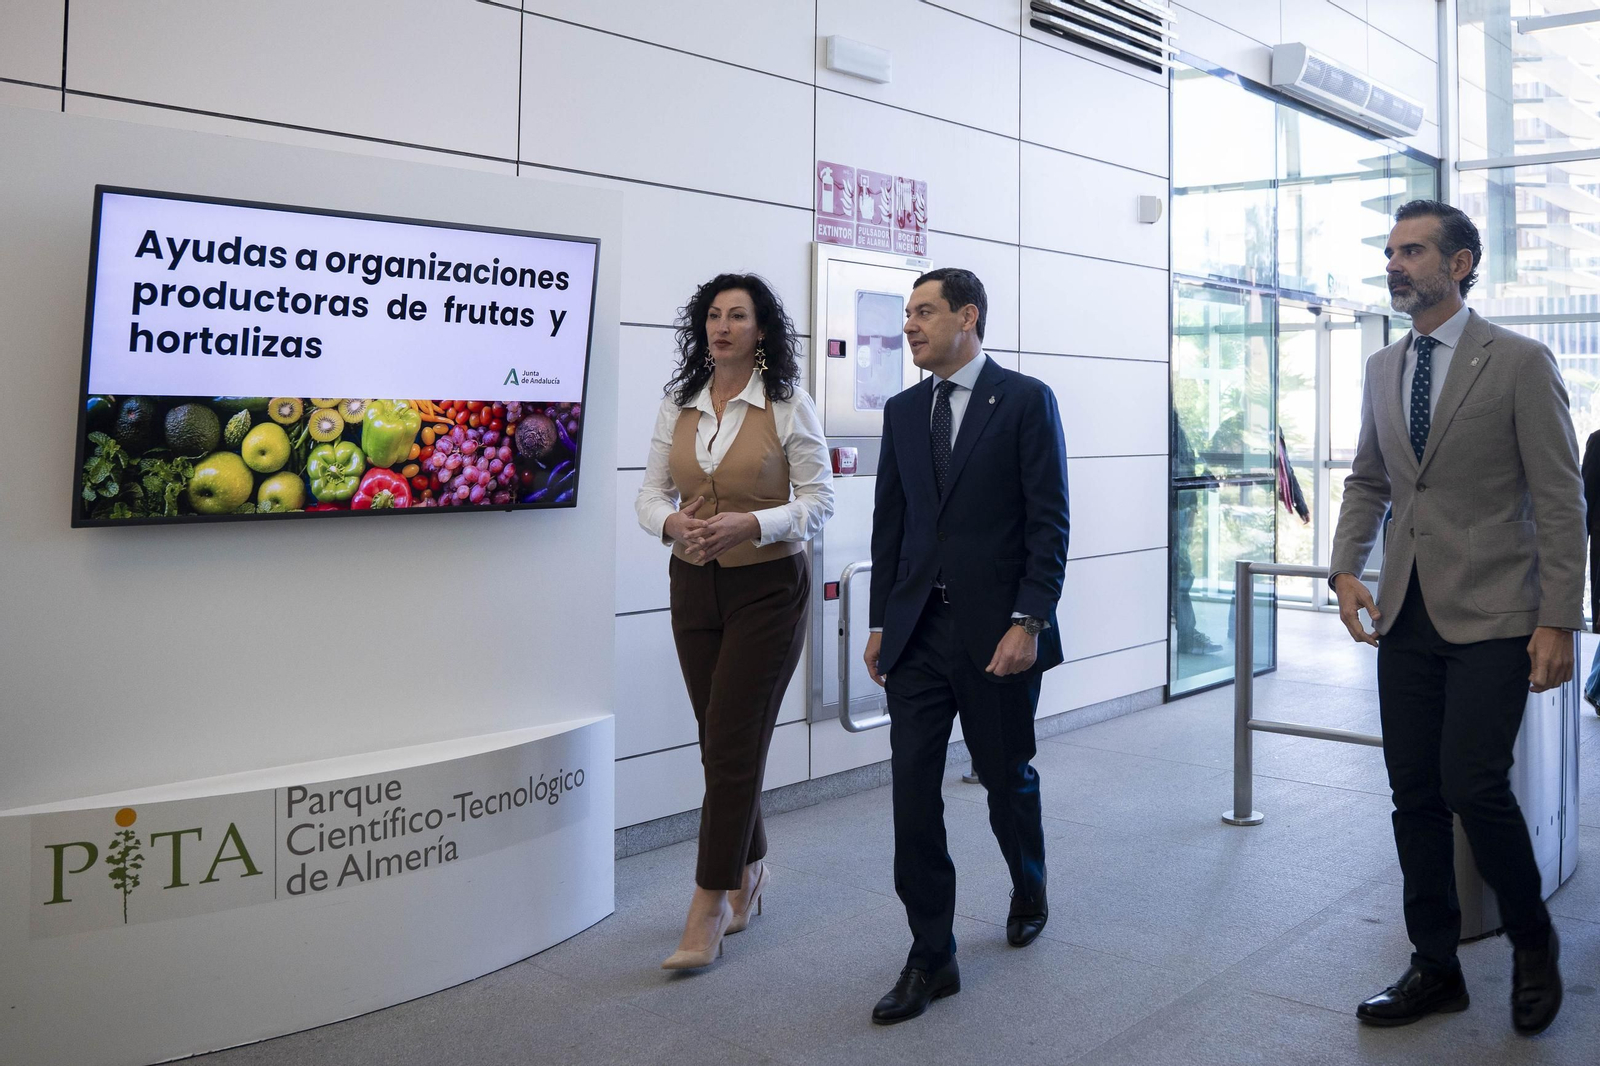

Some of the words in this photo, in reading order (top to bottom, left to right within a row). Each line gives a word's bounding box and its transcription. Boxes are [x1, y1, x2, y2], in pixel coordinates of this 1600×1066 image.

[818, 224, 852, 239] EXTINTOR
[858, 226, 890, 238] PULSADOR
[858, 237, 865, 245] DE
[866, 238, 890, 249] ALARMA
[896, 242, 925, 253] INCENDIO
[897, 233, 914, 242] BOCA
[915, 235, 923, 244] DE
[135, 229, 288, 271] Ayudas
[295, 249, 317, 272] a
[326, 250, 570, 290] organizaciones
[131, 280, 369, 318] productoras
[386, 293, 427, 321] de
[443, 297, 535, 327] frutas
[549, 309, 567, 337] y
[129, 322, 323, 359] hortalizas
[286, 768, 585, 856] Científico-Tecnológico
[287, 779, 402, 818] Parque
[286, 862, 328, 896] de
[336, 834, 459, 887] Almería
